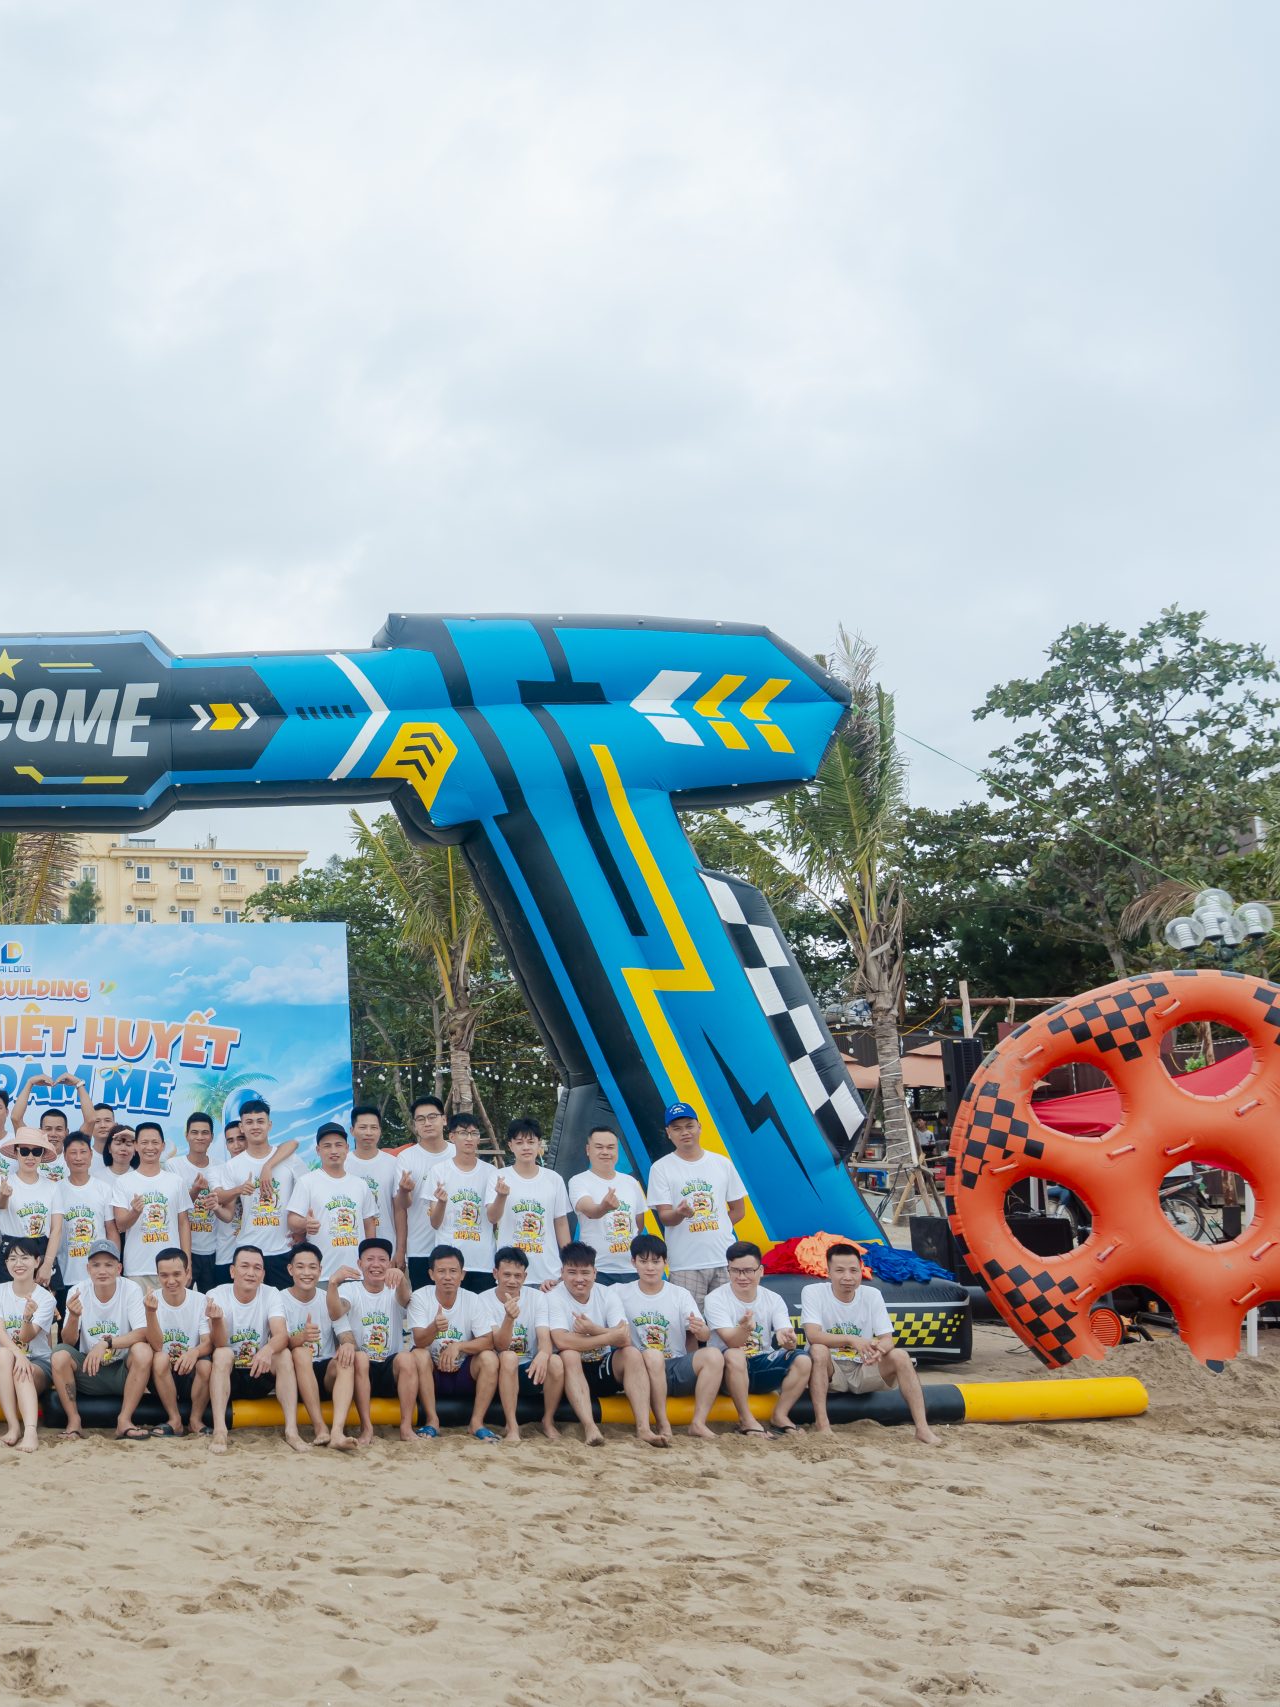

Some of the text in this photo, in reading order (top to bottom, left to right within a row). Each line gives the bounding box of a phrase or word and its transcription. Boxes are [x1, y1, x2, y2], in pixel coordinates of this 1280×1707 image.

[8, 965, 31, 973] LONG
[82, 1008, 241, 1070] HUYẾT
[102, 1060, 177, 1117] MÊ
